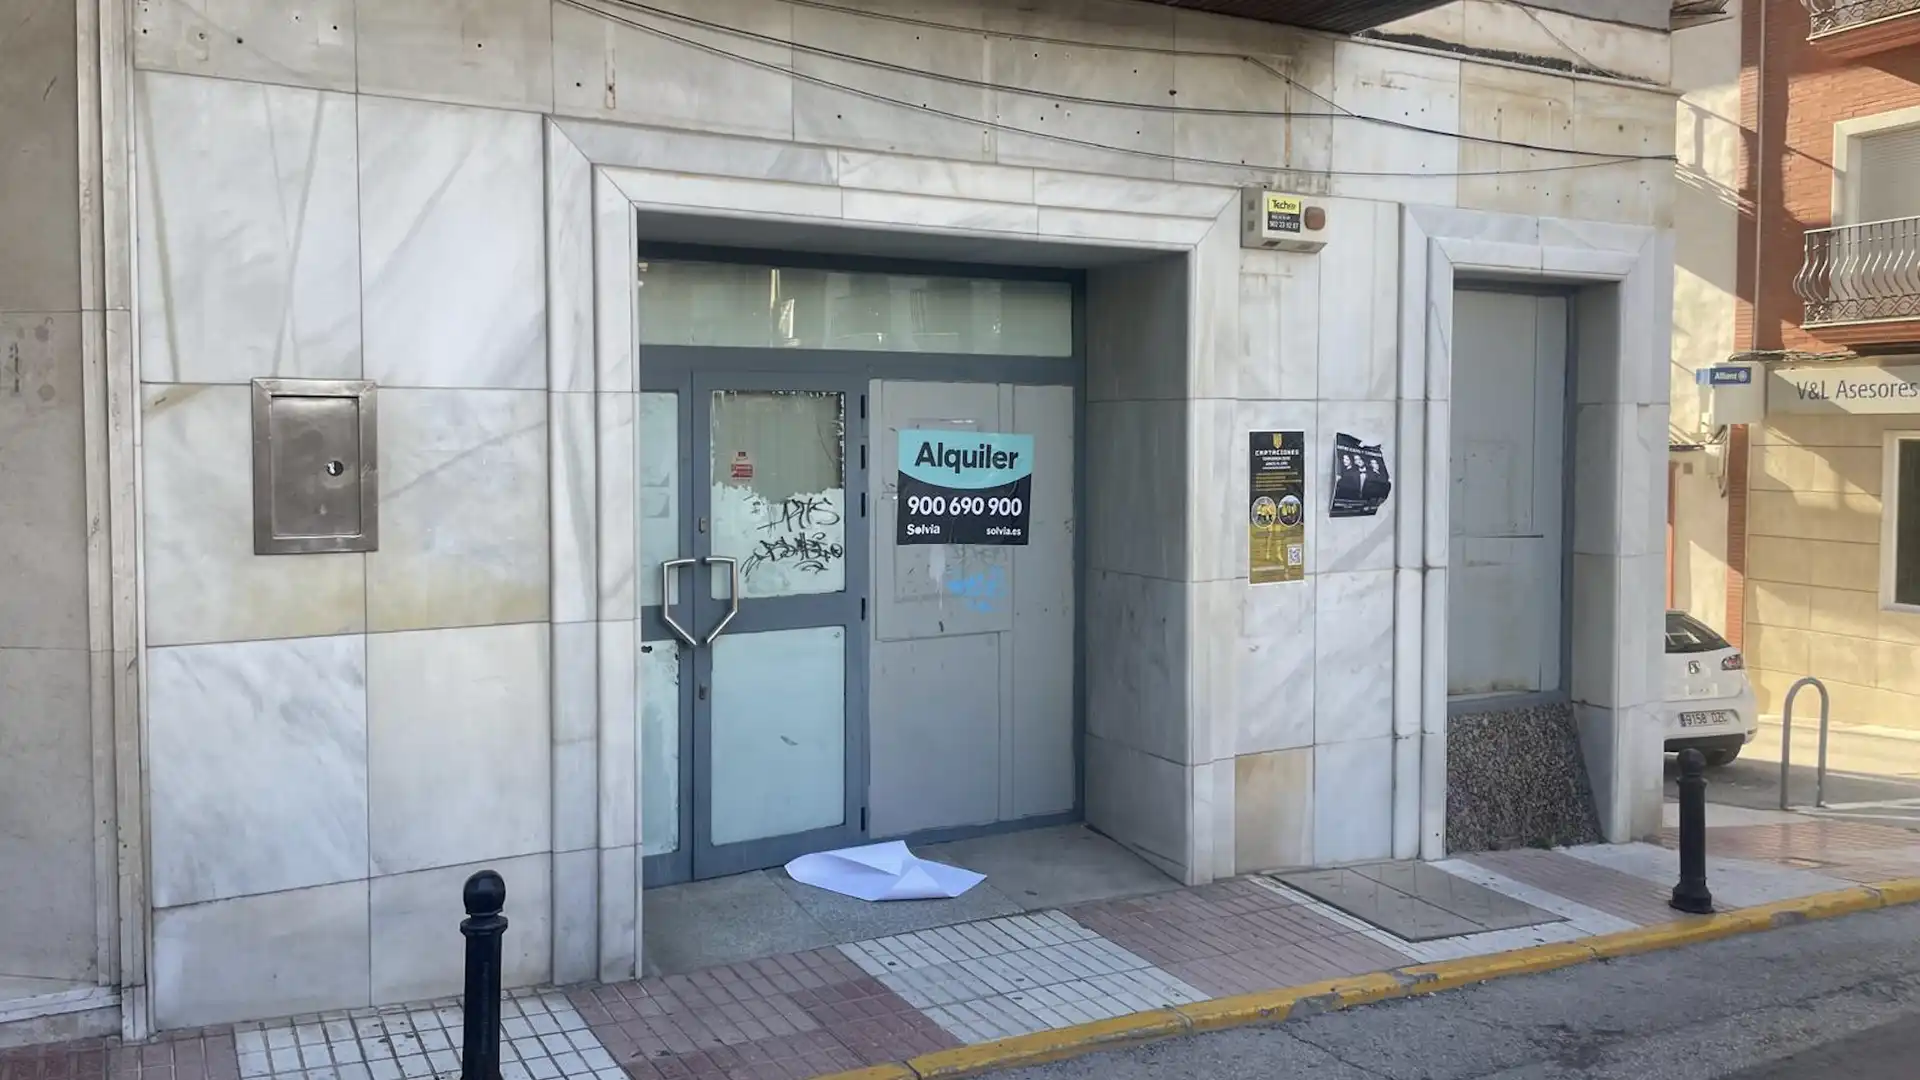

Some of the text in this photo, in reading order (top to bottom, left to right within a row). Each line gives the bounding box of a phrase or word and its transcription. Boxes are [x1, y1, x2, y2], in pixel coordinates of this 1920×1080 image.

[1797, 380, 1918, 400] V&L Asesores
[915, 441, 1019, 474] Alquiler
[907, 496, 1022, 516] 900 690 900
[906, 524, 941, 536] Solvia
[986, 526, 1022, 537] solvia.es
[1685, 712, 1708, 725] 9158
